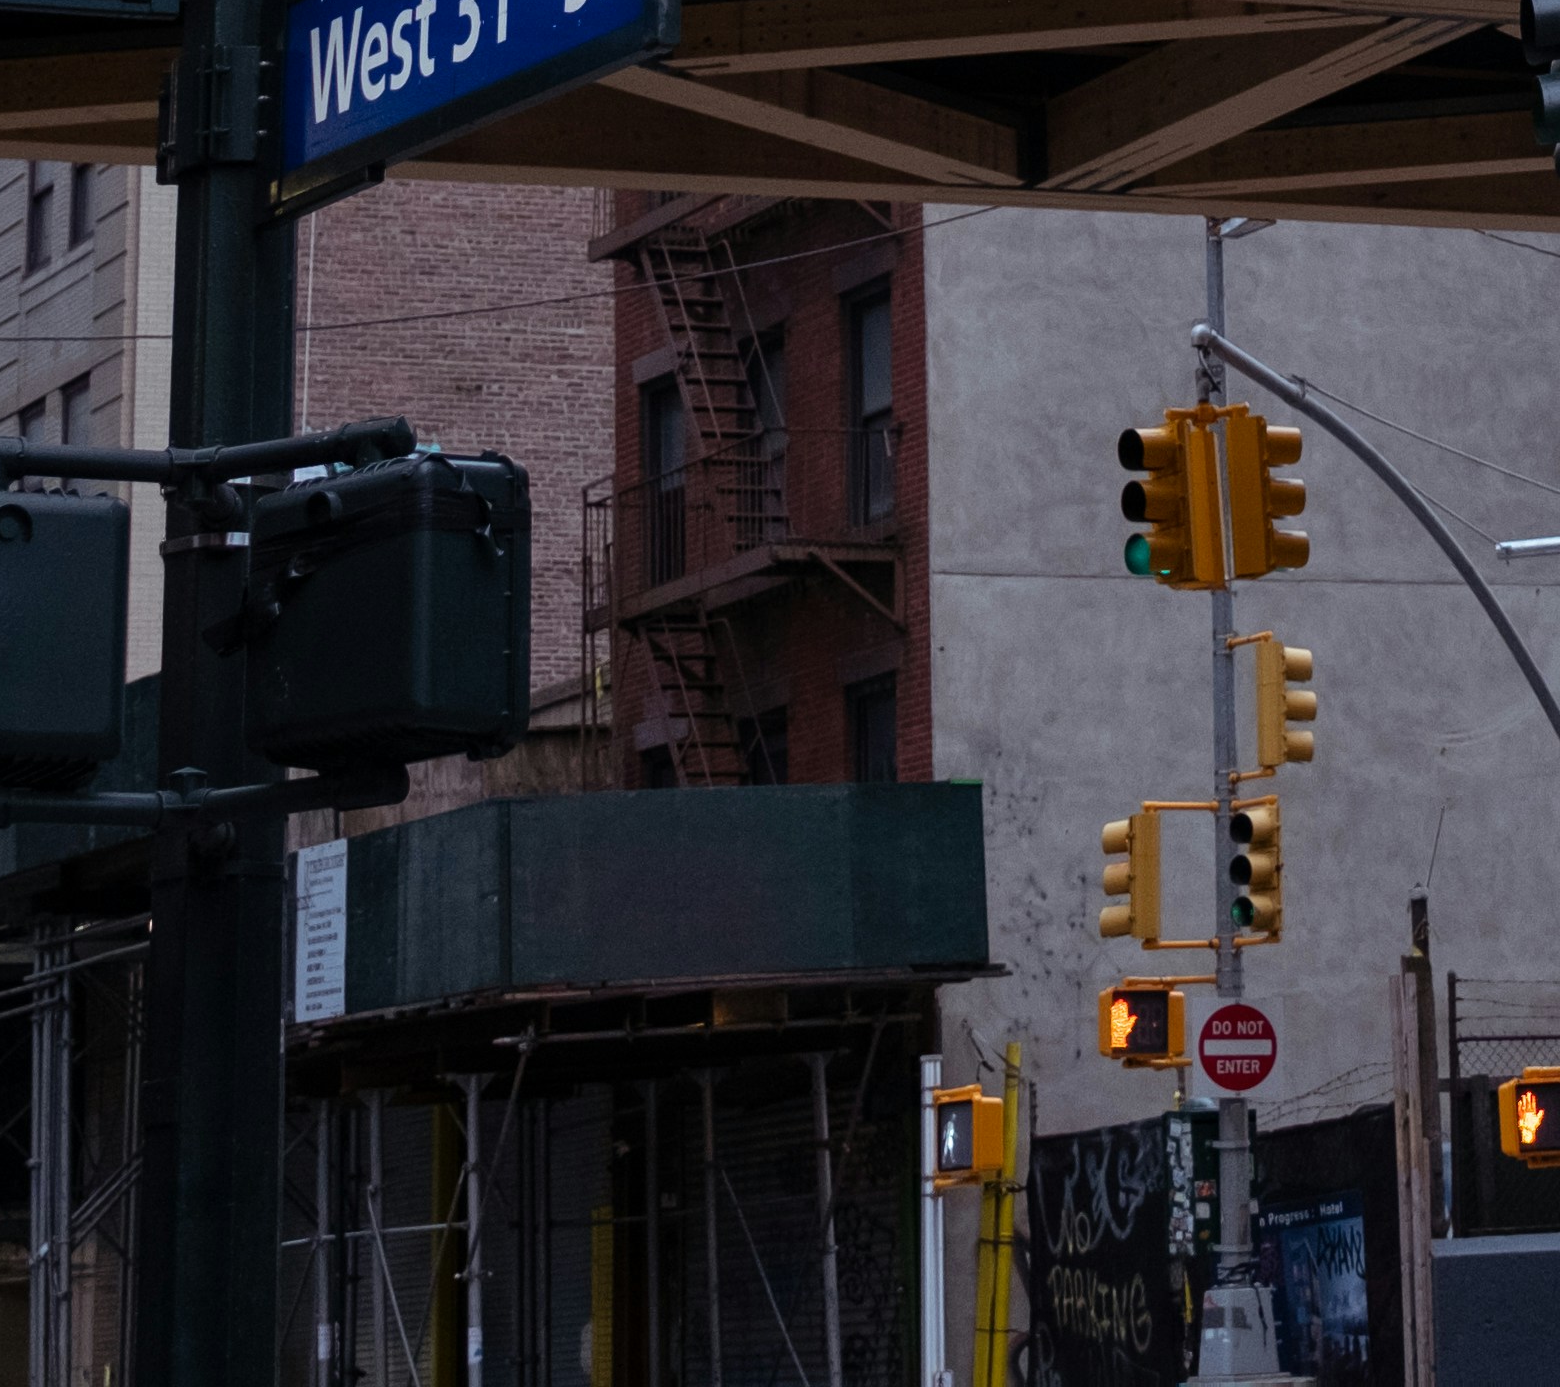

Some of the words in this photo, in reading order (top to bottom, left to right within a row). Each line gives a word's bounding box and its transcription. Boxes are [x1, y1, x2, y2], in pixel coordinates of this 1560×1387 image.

[1212, 1020, 1232, 1036] DO
[1237, 1020, 1264, 1036] NOT
[1216, 1059, 1261, 1075] ENTER
[1047, 1262, 1153, 1354] PARKING
